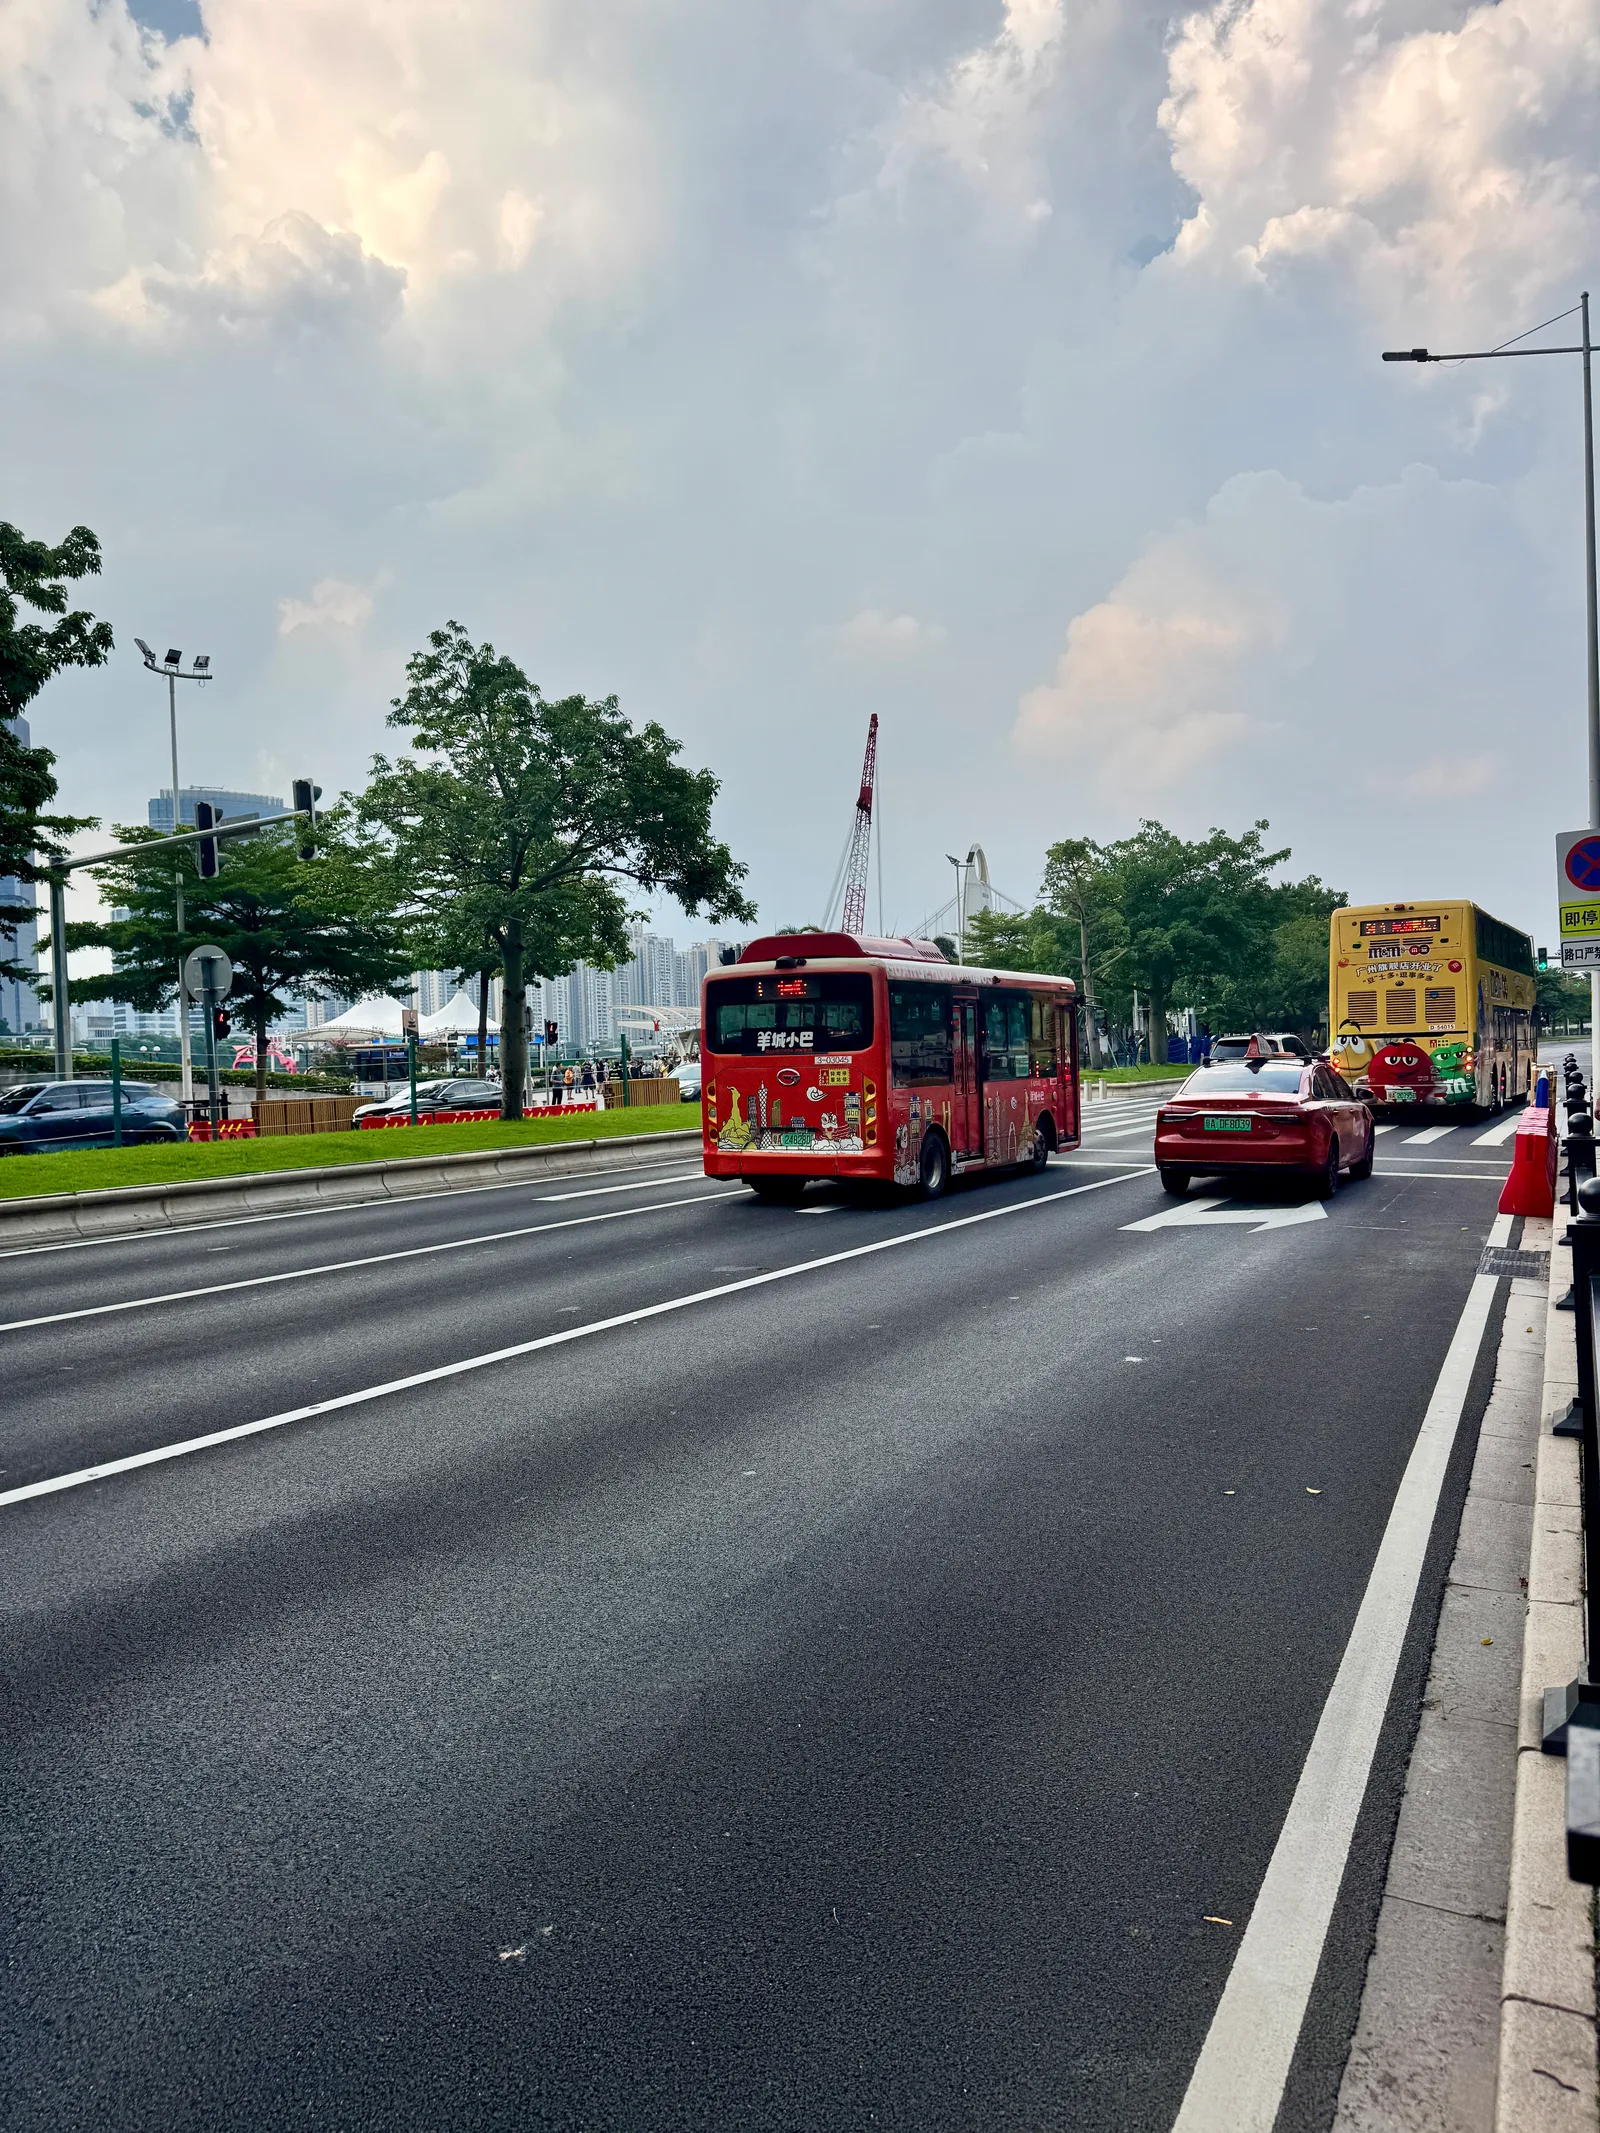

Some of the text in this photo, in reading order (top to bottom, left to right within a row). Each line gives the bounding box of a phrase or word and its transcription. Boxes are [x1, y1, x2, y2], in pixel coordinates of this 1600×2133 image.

[1565, 909, 1600, 927] 即停
[1356, 961, 1443, 977] 广州旗舰店开业了
[757, 1031, 814, 1051] 羊城小巴
